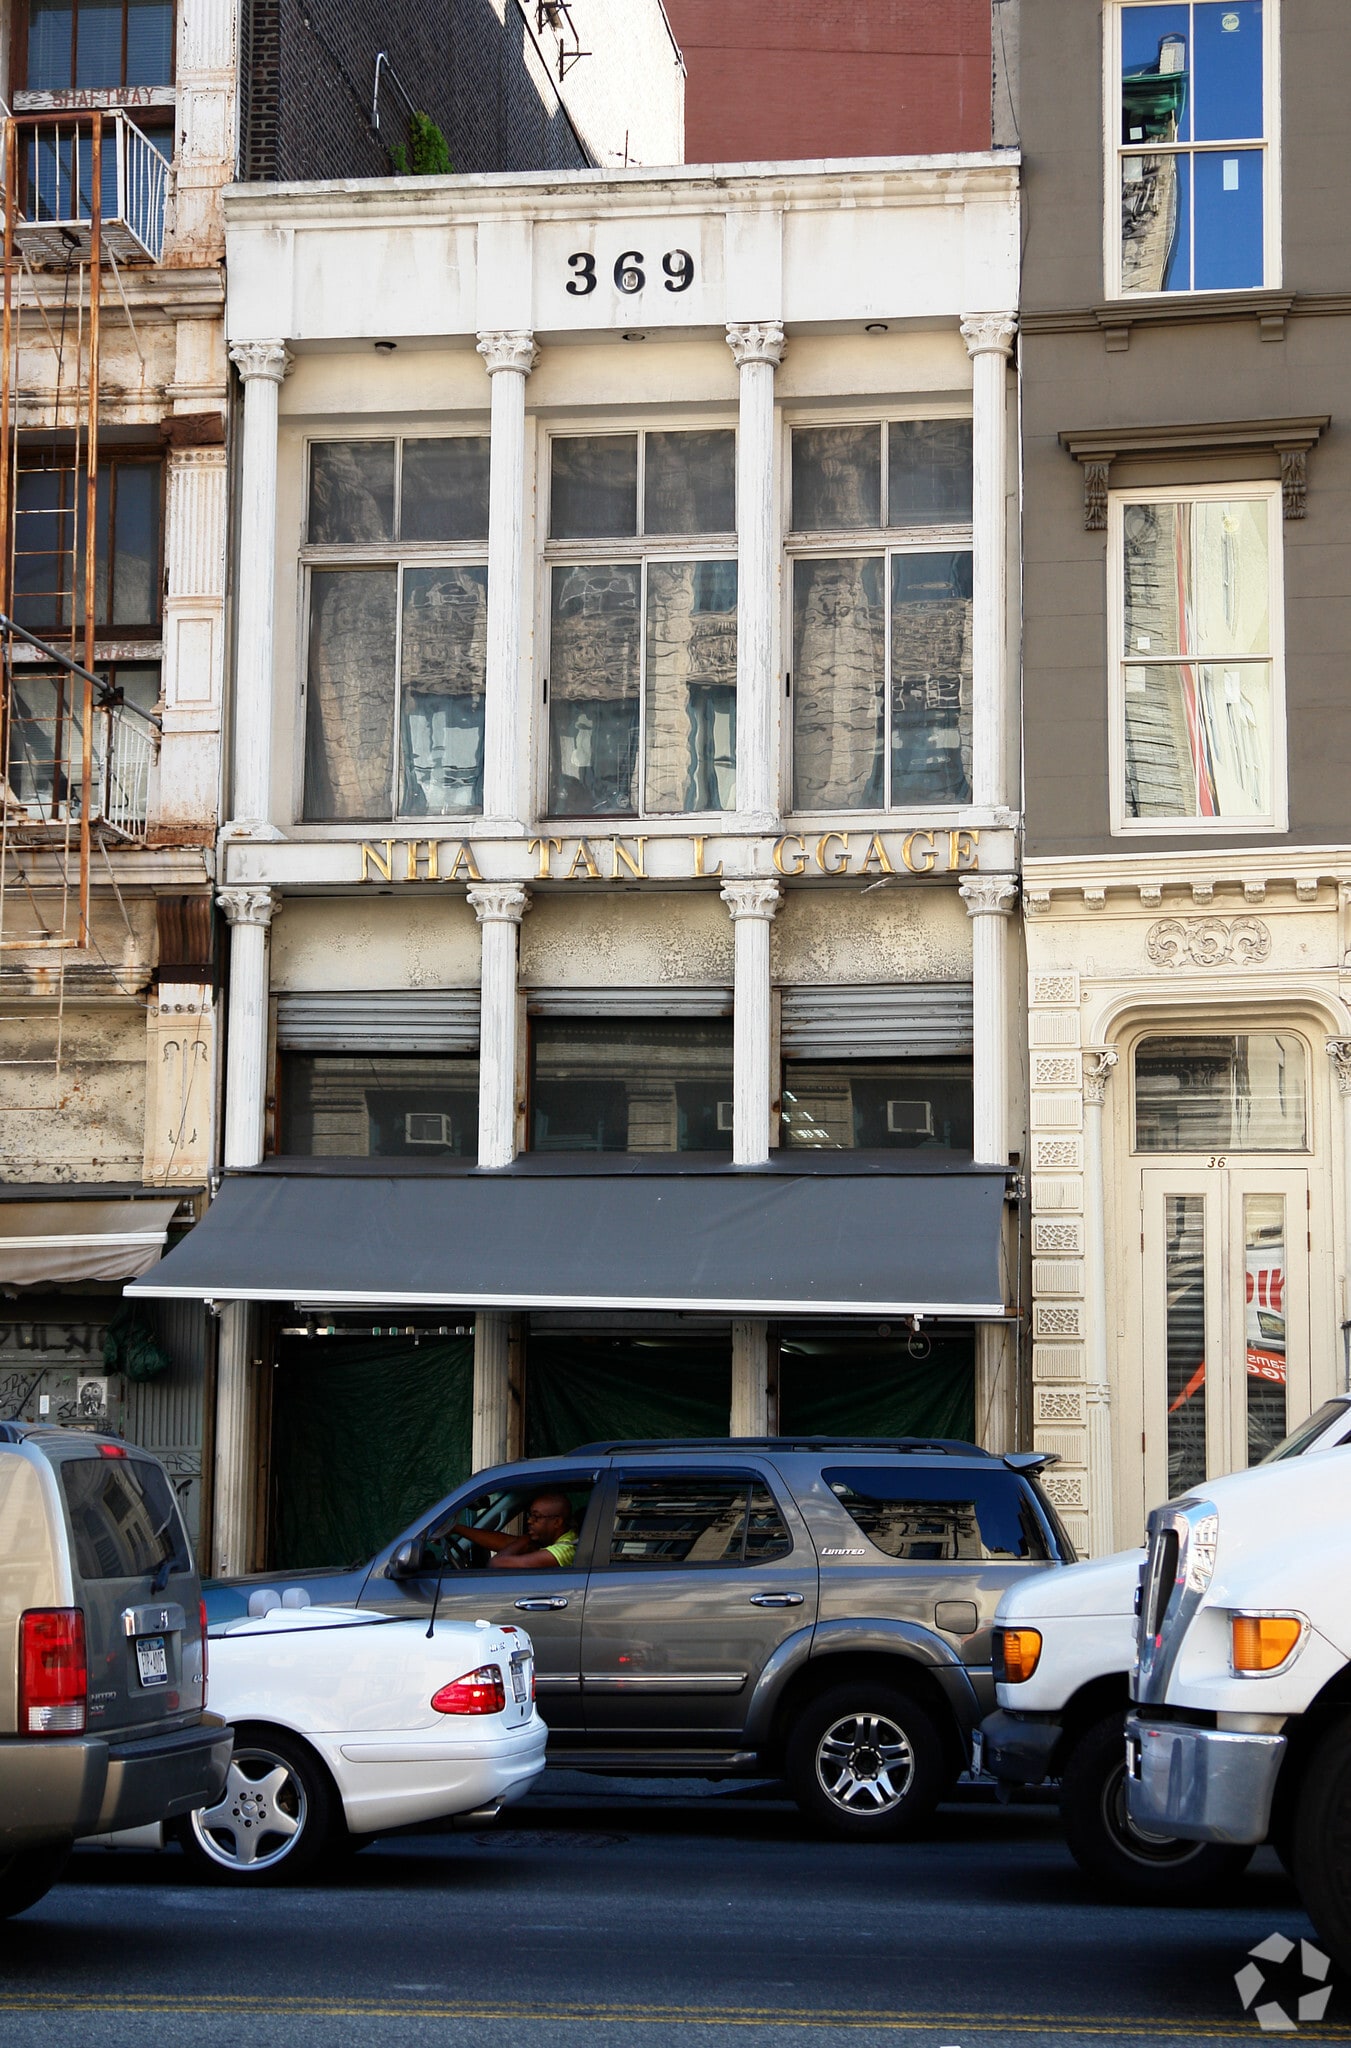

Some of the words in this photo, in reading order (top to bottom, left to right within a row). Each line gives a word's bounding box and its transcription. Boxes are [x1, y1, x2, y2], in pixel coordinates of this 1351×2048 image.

[52, 86, 156, 108] SHAFTWAY
[565, 249, 695, 296] 369
[356, 837, 485, 882] NHA
[528, 834, 649, 880] TAN
[687, 834, 724, 878] L
[772, 829, 980, 875] GGAGE
[1207, 1156, 1227, 1168] 36
